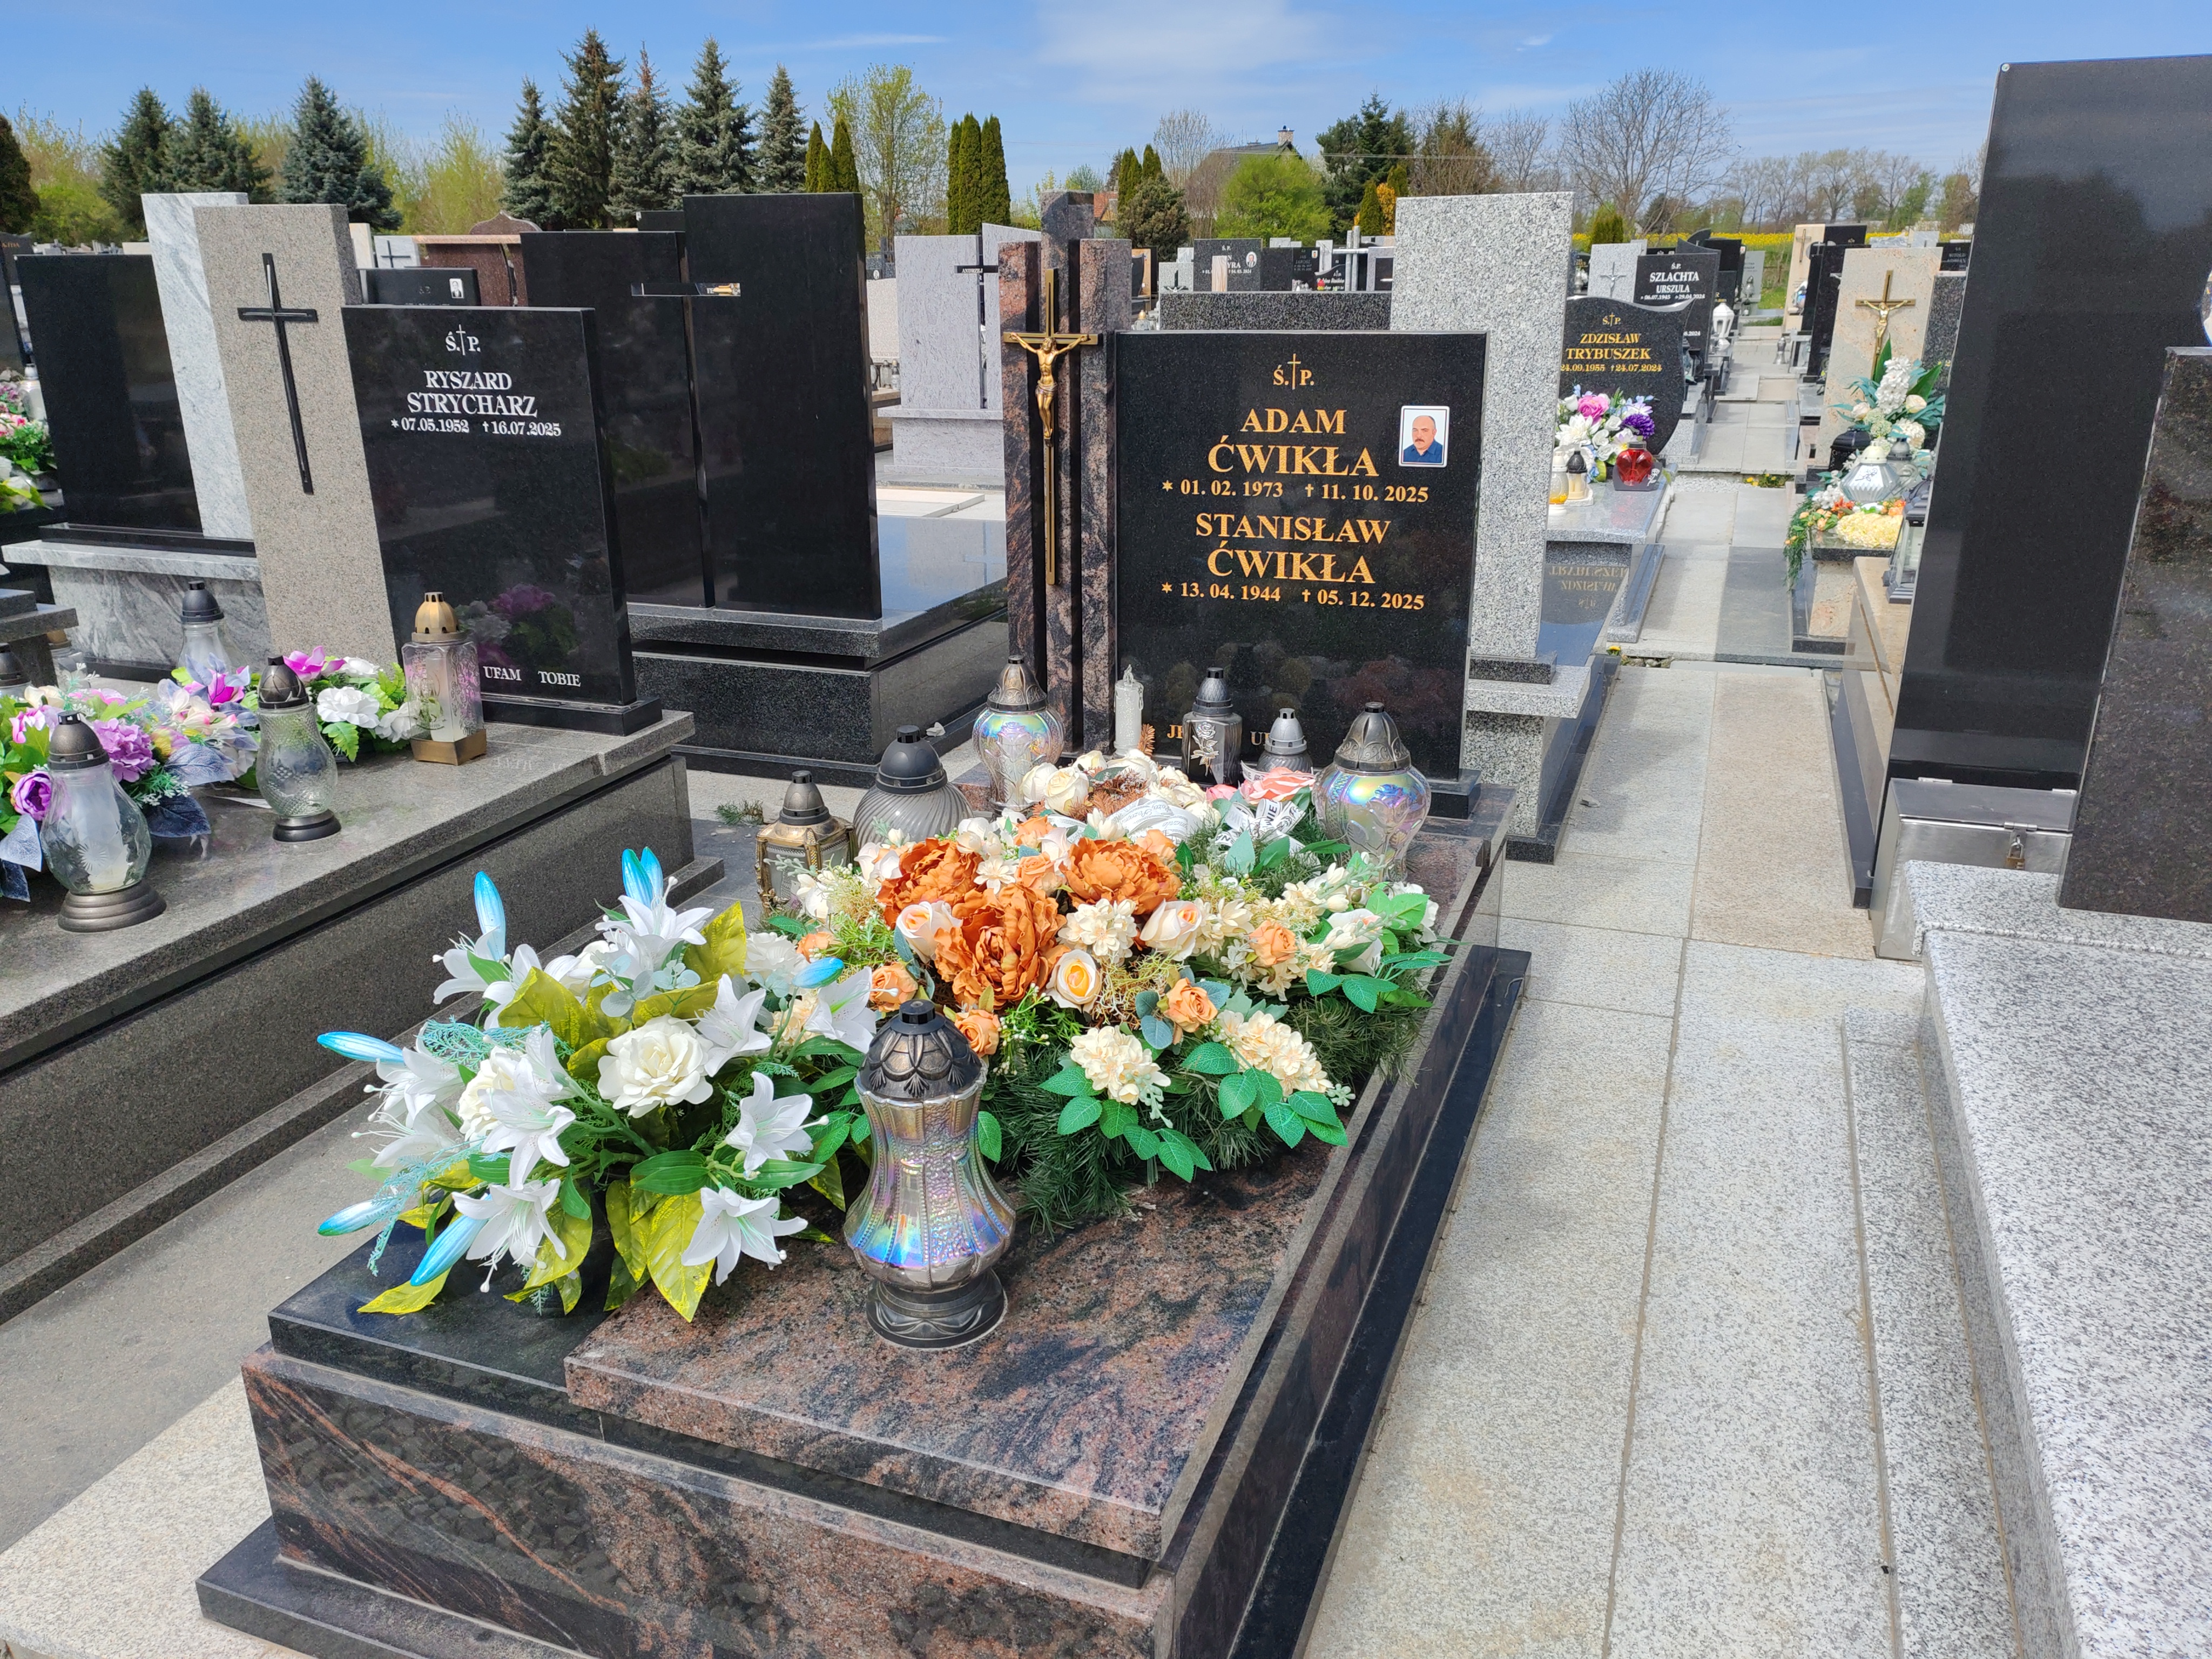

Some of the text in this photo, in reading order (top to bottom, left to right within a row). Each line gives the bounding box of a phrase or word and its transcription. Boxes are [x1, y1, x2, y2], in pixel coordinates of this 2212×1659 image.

[1649, 272, 1700, 282] SZLACHTA
[1656, 284, 1690, 293] URSZULA
[1580, 333, 1641, 345] ZDZISŁAW
[1566, 348, 1651, 360] TRYBUSZEK
[1273, 365, 1314, 386] Ś. P.
[1615, 363, 1663, 372] 24.07.2024
[423, 370, 512, 390] RYSZARD
[407, 392, 537, 417] STRYCHARZ
[401, 417, 562, 436] 07.05.1952 16.07.2025
[1240, 408, 1347, 434] ADAM
[1208, 435, 1379, 476] ĆWIKŁA
[1181, 479, 1428, 503] 01. 02. 1973 11. 10. 2025
[1196, 512, 1391, 544] STANISŁAW
[1208, 541, 1375, 584] ĆWIKŁA
[1182, 582, 1424, 610] 13. 04. 1944 05. 12. 2025
[483, 666, 581, 687] UFAM TOBIE
